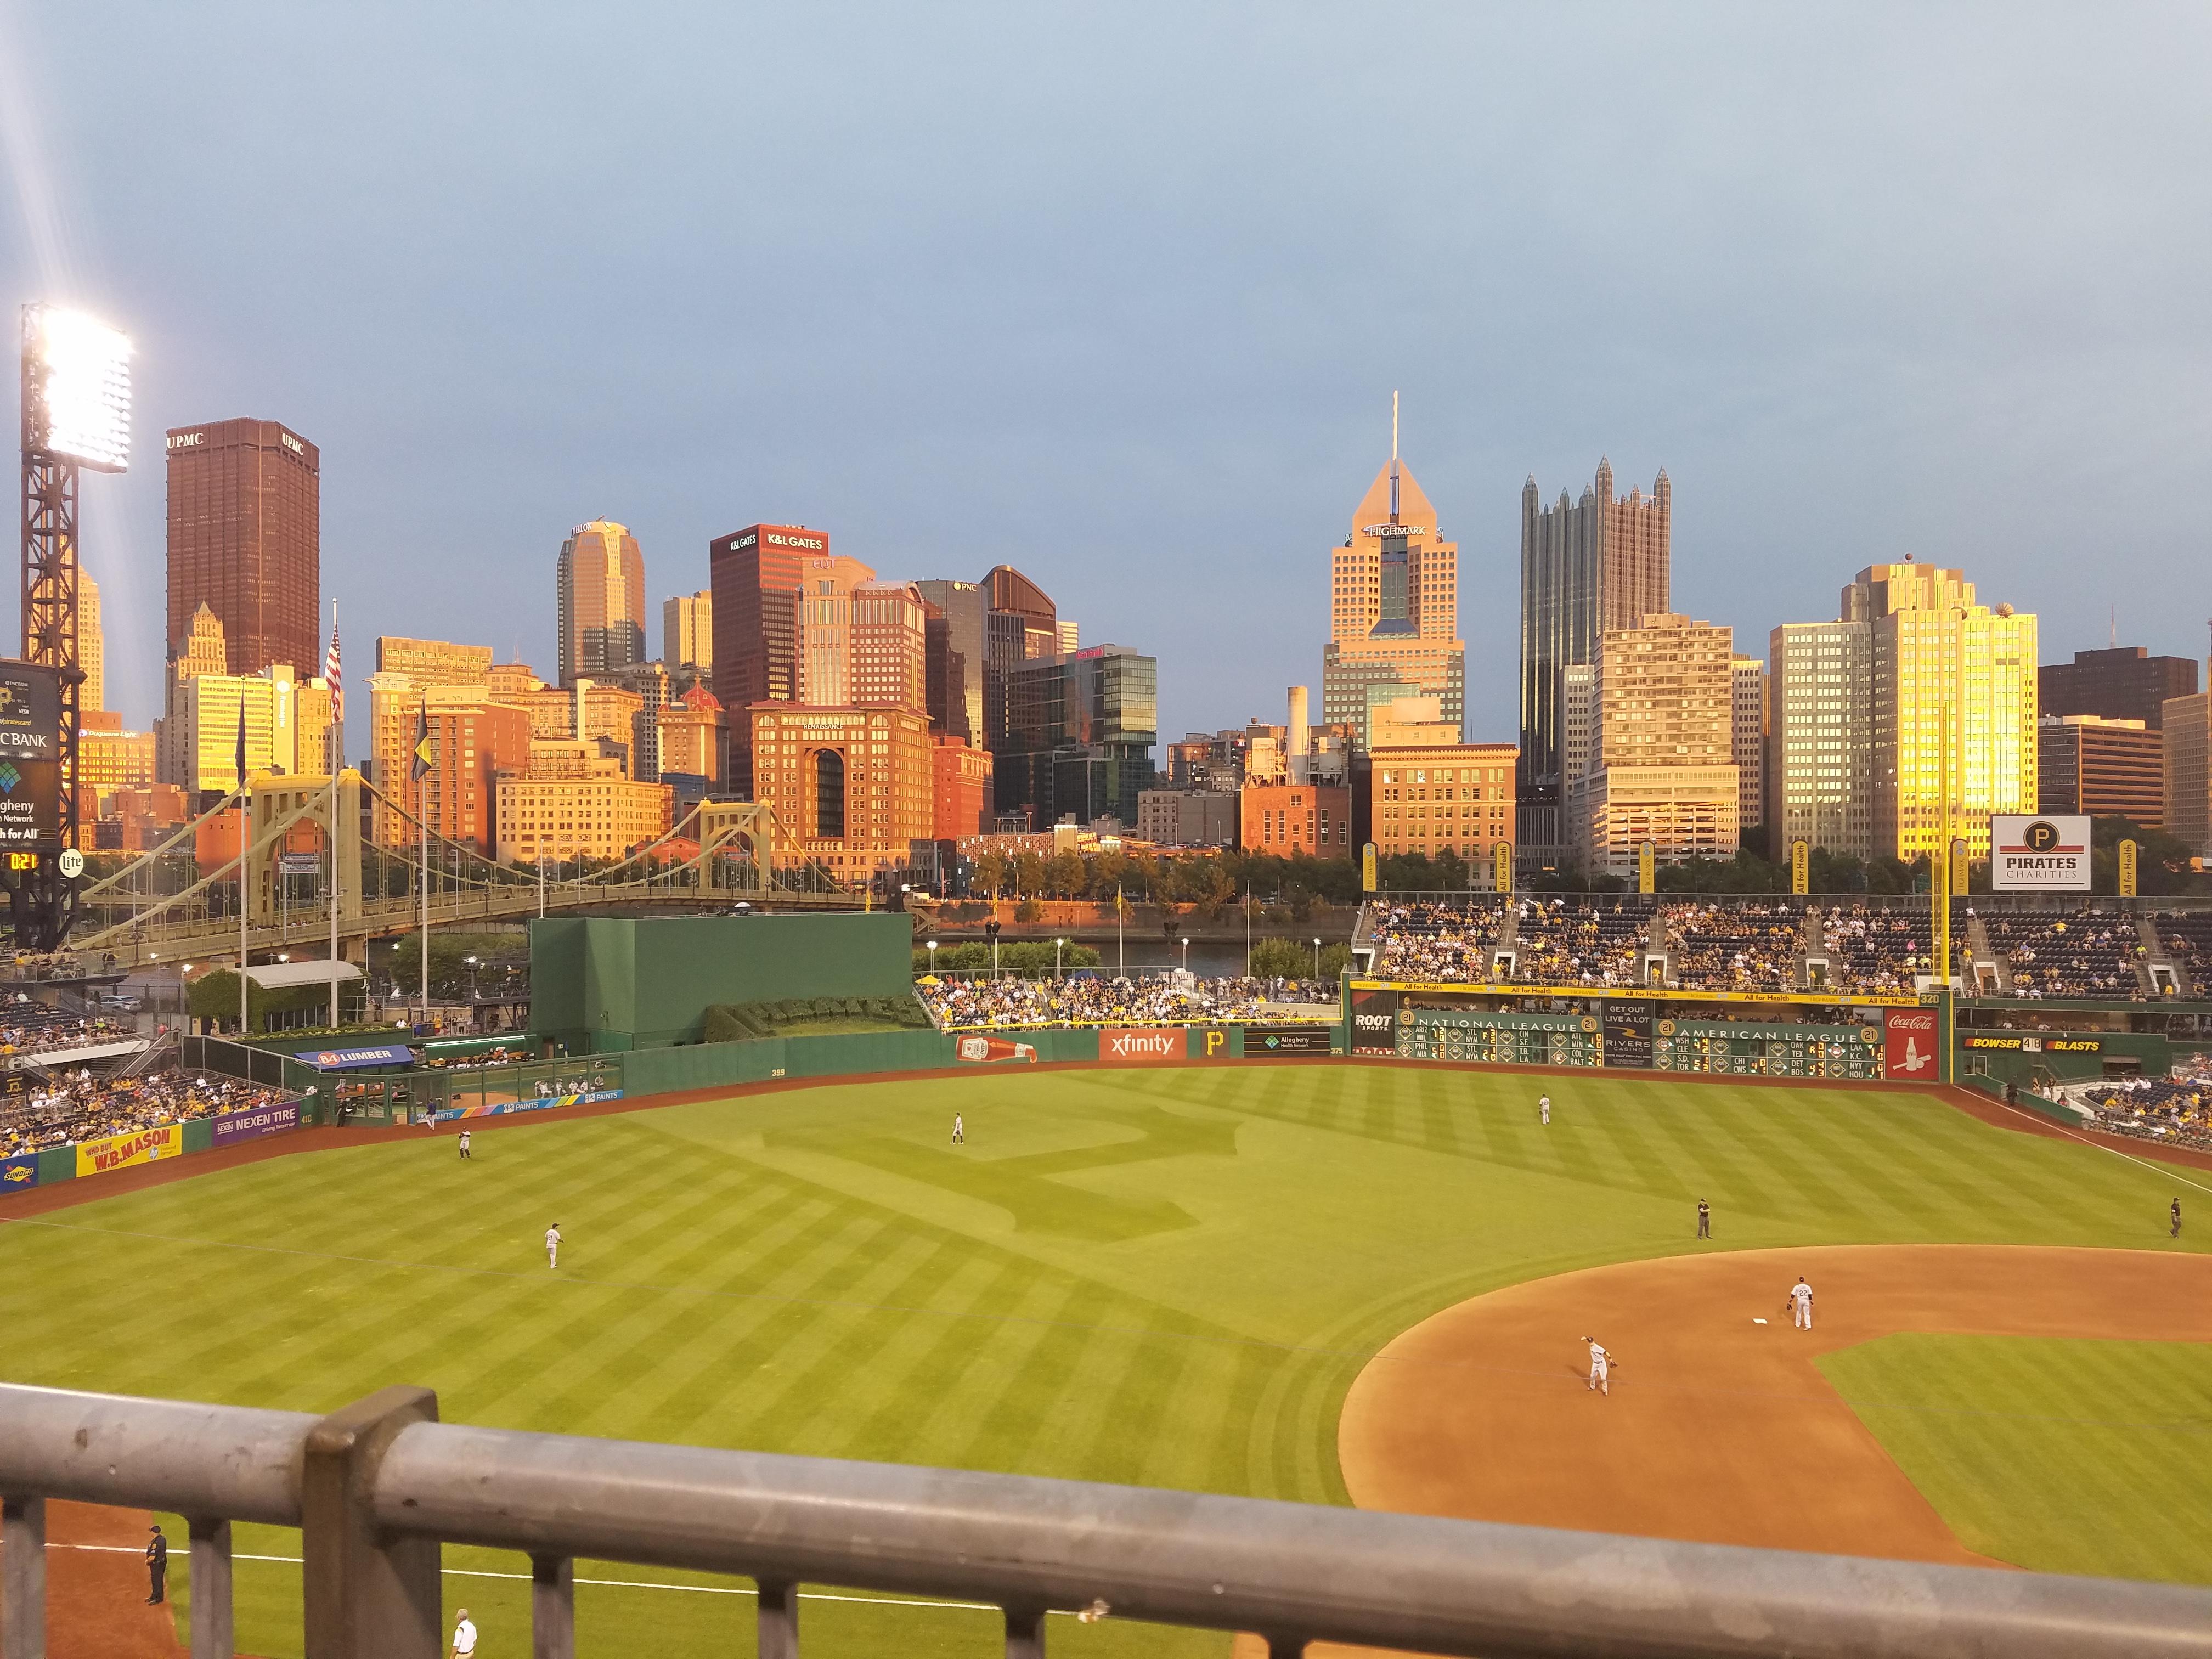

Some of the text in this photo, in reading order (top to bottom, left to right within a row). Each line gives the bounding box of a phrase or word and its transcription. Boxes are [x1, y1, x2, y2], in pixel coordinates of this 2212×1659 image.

[166, 433, 203, 449] UPMC
[281, 432, 303, 455] UPMC
[1370, 526, 1426, 537] HIGHMARK
[730, 535, 756, 550] K&L GATES
[768, 534, 822, 549] K&L GATES
[962, 583, 976, 591] PNC
[8, 828, 22, 839] for
[23, 828, 37, 839] All
[2035, 828, 2049, 847] P
[62, 856, 81, 870] Lite
[2007, 858, 2076, 868] PIRATES
[1921, 995, 1939, 1003] 320
[1356, 1015, 1392, 1026] ROOT
[1419, 1018, 1576, 1031] NATIONAL LEAGUE
[1889, 1015, 1934, 1029] Coca-Cola
[1680, 1029, 1857, 1042] AMERICAN LEAGUE
[1865, 1031, 1874, 1039] 21
[1111, 1034, 1174, 1056] xfinity
[1207, 1032, 1224, 1056] P
[1973, 1039, 2021, 1048] BOWSER
[2055, 1041, 2099, 1051] BLASTS
[340, 1050, 392, 1062] LUMBER
[516, 1102, 539, 1110] PAINTS
[236, 1113, 270, 1131] NEXEN
[272, 1108, 295, 1122] TIRE
[302, 1115, 312, 1124] 410
[86, 1142, 112, 1156] WHO BUT
[5, 1169, 33, 1180] SUNOCO
